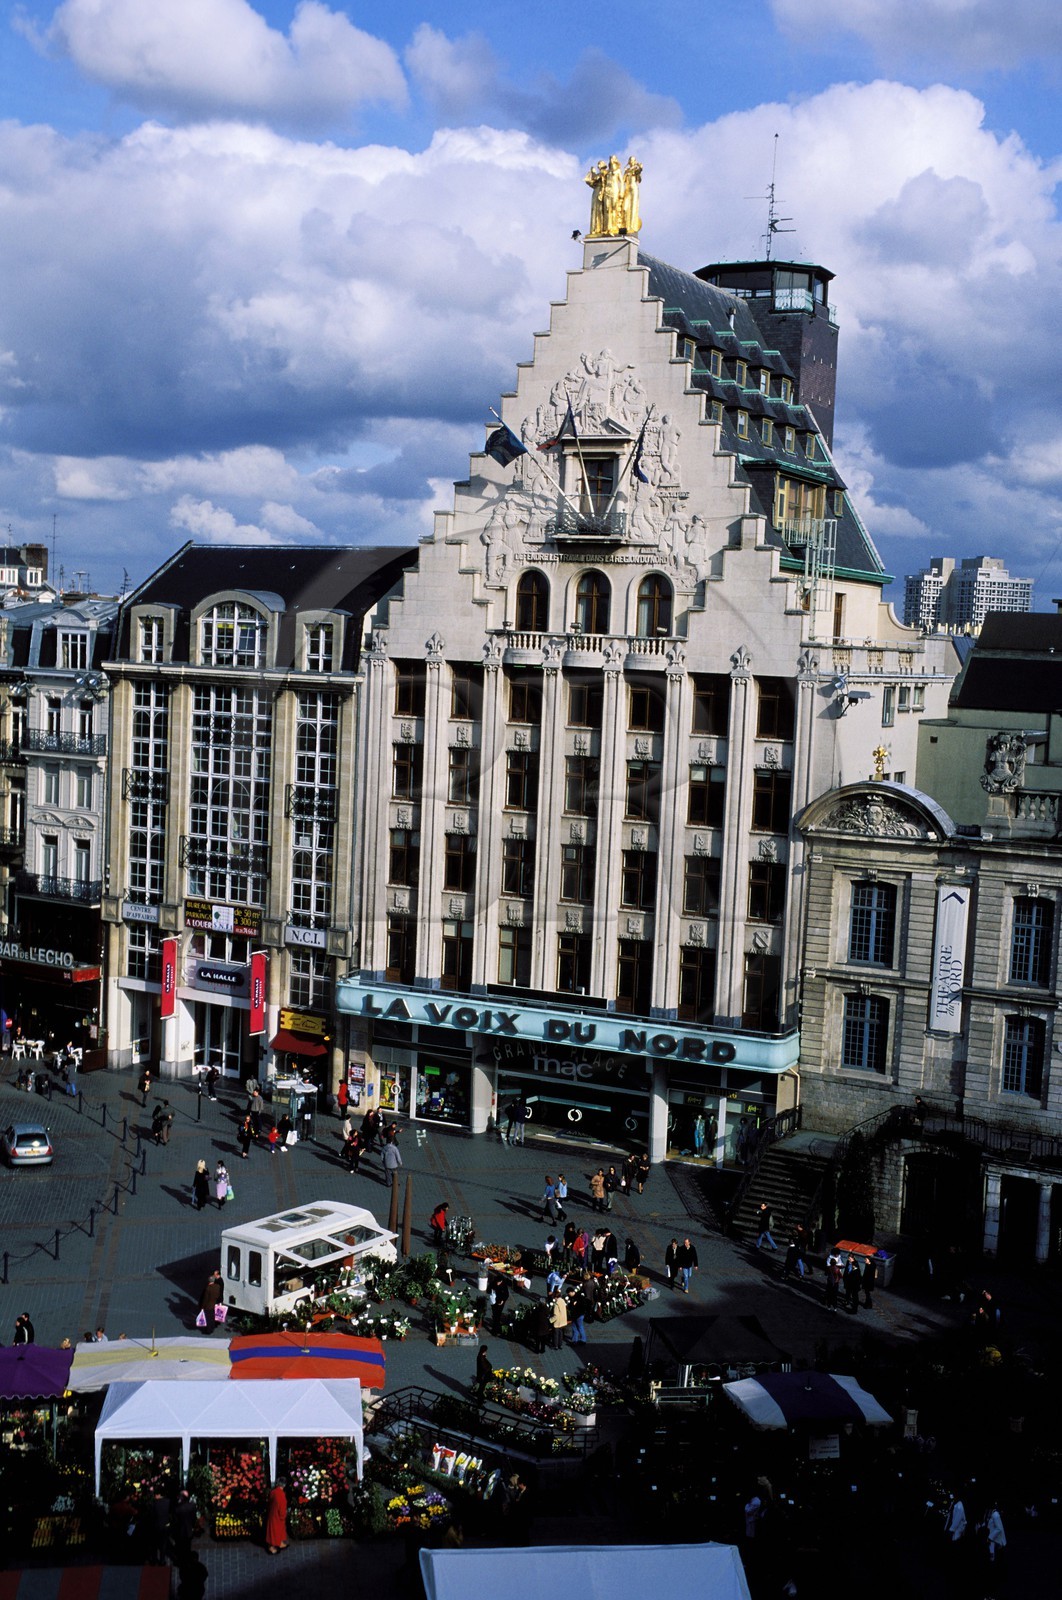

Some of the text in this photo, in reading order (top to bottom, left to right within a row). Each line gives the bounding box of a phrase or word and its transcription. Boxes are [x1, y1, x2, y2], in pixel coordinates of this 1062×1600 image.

[126, 911, 157, 921] D'AFFAIRES
[130, 905, 152, 914] CENTRE
[243, 910, 252, 918] 50
[192, 919, 212, 929] LOUER
[240, 917, 252, 926] 300
[291, 930, 321, 945] N.C.I.
[29, 945, 74, 969] L'ECHO
[200, 971, 237, 983] LA HALLE
[947, 959, 963, 1005] NORD
[361, 994, 737, 1064] LA VOIX DU NORD
[492, 1043, 629, 1080] GRAND PLACE
[533, 1053, 594, 1079] fnac
